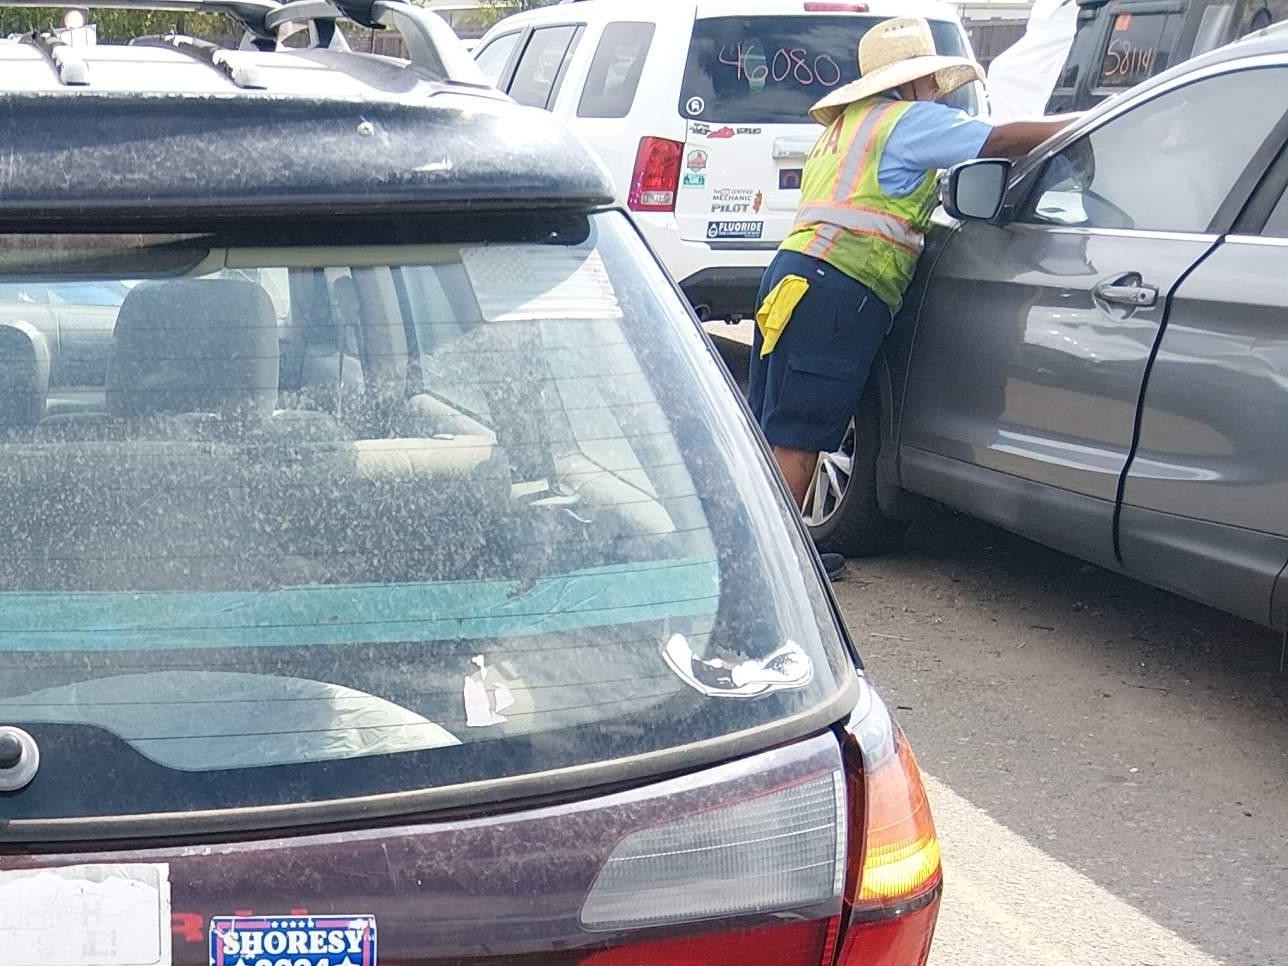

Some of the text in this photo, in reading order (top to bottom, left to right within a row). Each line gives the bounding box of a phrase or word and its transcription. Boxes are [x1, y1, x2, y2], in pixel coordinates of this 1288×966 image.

[718, 44, 840, 86] 46080
[711, 203, 750, 213] PILOT
[718, 222, 762, 232] FLUORIDE
[223, 929, 365, 955] SHORESY
